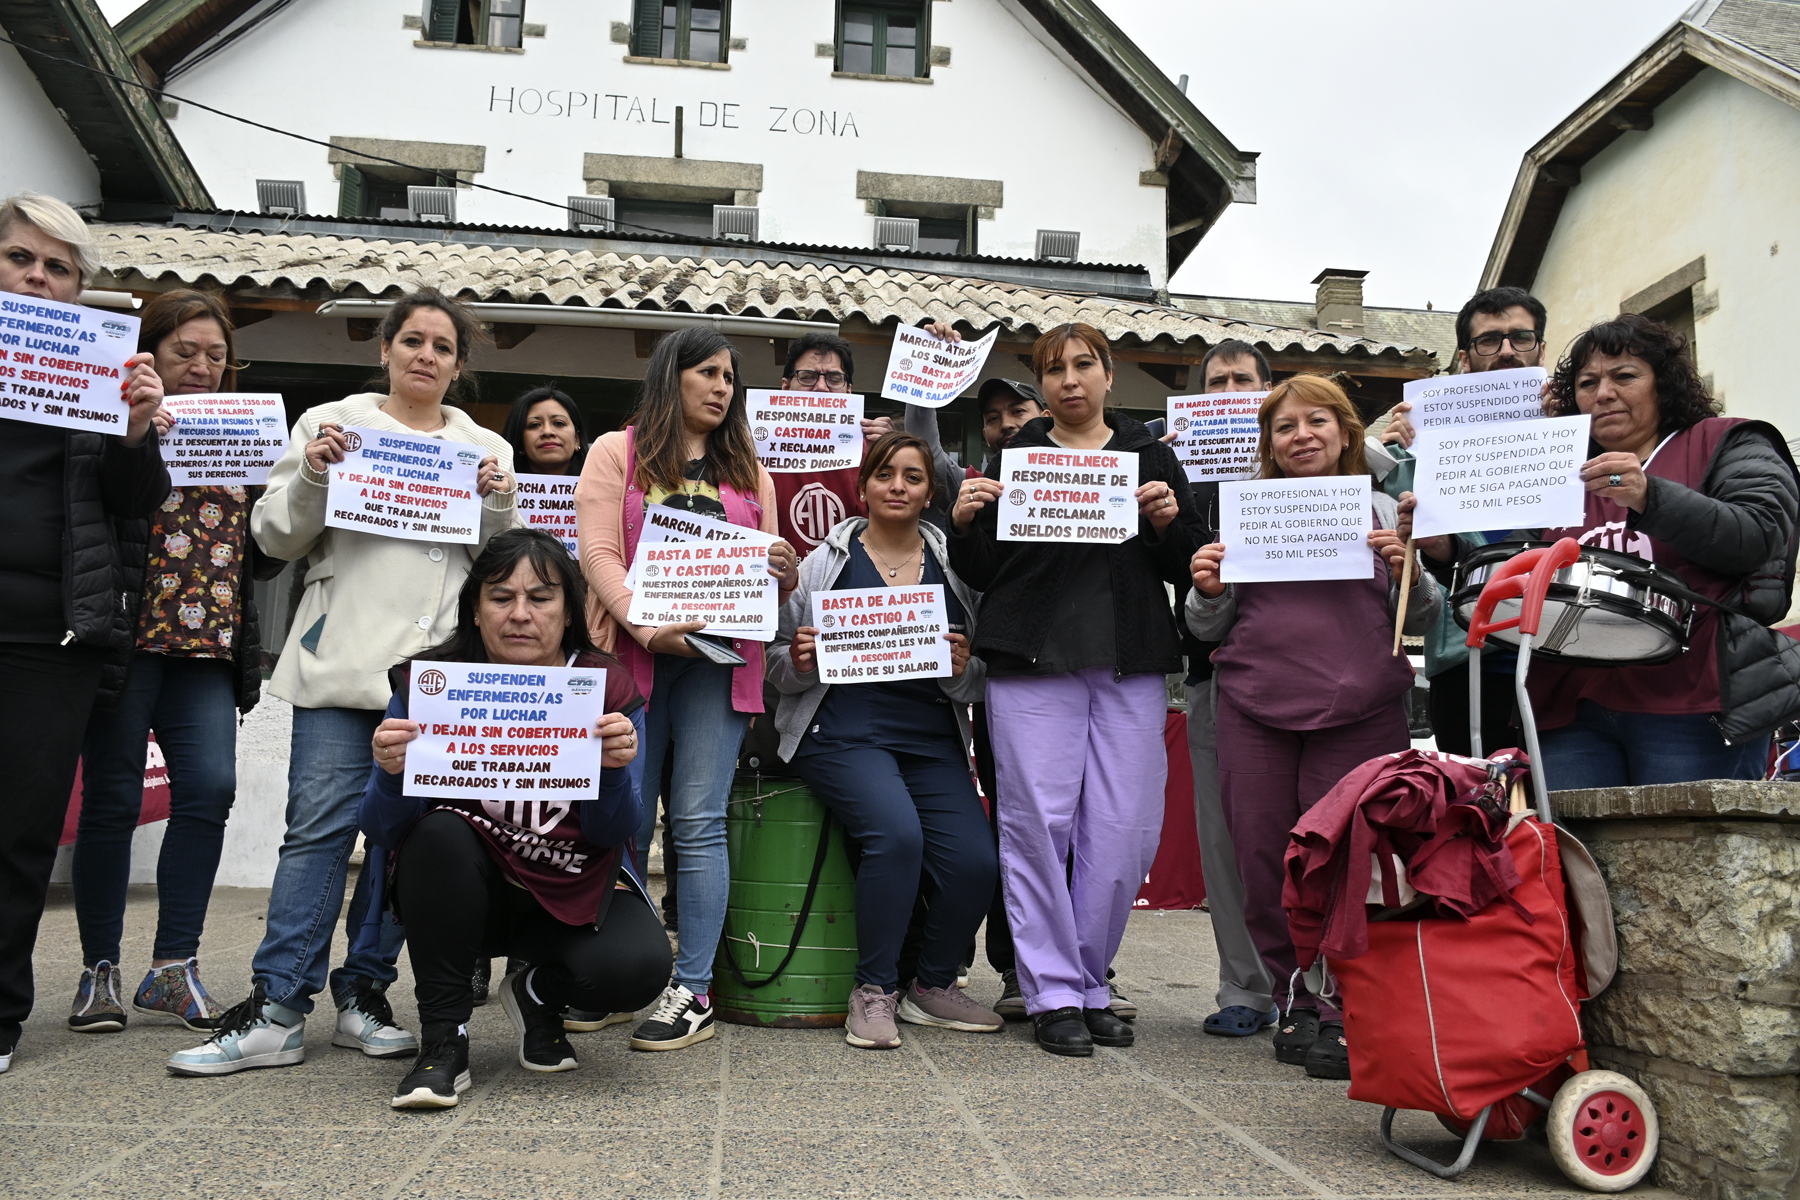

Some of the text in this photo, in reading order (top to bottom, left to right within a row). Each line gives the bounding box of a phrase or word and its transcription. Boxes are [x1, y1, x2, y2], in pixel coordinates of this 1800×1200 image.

[488, 85, 860, 137] HOSPITAL DE ZONA
[1, 301, 80, 324] SUSPENDEN
[25, 337, 80, 356] LUCHAR
[21, 370, 89, 389] SERVICIOS
[922, 366, 964, 379] BASTA DE
[12, 384, 80, 403] TRABAJAN
[891, 383, 923, 398] POR UN
[1423, 390, 1440, 398] SOY
[1444, 382, 1510, 395] PROFESIONAL
[1522, 379, 1543, 389] HOY
[770, 396, 847, 408] WERETILNECK
[1424, 394, 1544, 412] ESTOY SUSPENDIDO POR
[756, 411, 855, 424] RESPONSABLE DE
[775, 427, 830, 439] CASTIGAR
[1439, 440, 1459, 450] SOY
[1463, 433, 1538, 447] PROFESIONAL
[1552, 429, 1577, 438] HOY
[379, 438, 440, 454] SUSPENDEN
[769, 442, 835, 454] X RECLAMAR
[1199, 437, 1245, 445] DESCUENTAN
[362, 449, 453, 470] ENFERMEROS/AS
[1028, 453, 1118, 468] WERETILNECK
[1439, 444, 1573, 465] ESTOY SUSPENDIDA POR
[811, 459, 852, 468] DIGNOS
[1436, 460, 1573, 480] PEDIR AL GOBIERNO QUE
[373, 464, 440, 481] POR LUCHAR
[1012, 471, 1128, 486] RESPONSABLE DE
[349, 474, 384, 486] DEJAN
[389, 480, 404, 490] SIN
[408, 483, 470, 499] COBERTURA
[1440, 476, 1566, 495] NO ME SIGA PAGANDO
[360, 488, 447, 509] A LOS SERVICIOS
[1034, 489, 1099, 503] CASTIGAR
[1240, 493, 1258, 501] SOY
[1262, 489, 1328, 499] PROFESIONAL
[1460, 494, 1541, 509] 350 MIL PESOS
[365, 502, 440, 520] QUE TRABAJAN
[1028, 507, 1105, 520] X RECLAMAR
[1242, 506, 1271, 515] ESTOY
[1274, 504, 1337, 514] SUSPENDIDA
[334, 510, 398, 528] RECARGADOS
[412, 523, 427, 531] SIN
[431, 525, 471, 535] INSUMOS
[1240, 521, 1267, 530] PEDIR
[1285, 518, 1338, 528] GOBIERNO
[1341, 518, 1362, 526] QUE
[1010, 524, 1129, 539] SUELDOS DIGNOS
[1282, 535, 1304, 543] SIGA
[1308, 532, 1358, 542] PAGANDO
[648, 547, 768, 560] BASTA DE AJUSTE
[1266, 550, 1283, 559] 350
[1307, 549, 1337, 557] PESOS
[664, 567, 671, 576] Y
[676, 564, 730, 576] CASTIGO
[735, 564, 744, 575] A
[692, 578, 768, 588] COMPAÑEROS/AS
[822, 592, 934, 610] BASTA DE AJUSTE
[839, 616, 846, 627] Y
[852, 612, 902, 626] CASTIGO
[907, 610, 916, 621] A
[821, 624, 940, 641] NUESTROS COMPAÑEROS/AS
[825, 636, 935, 652] ENFERMERAS/OS LES VAN
[861, 651, 911, 662] DESCONTAR
[842, 666, 863, 677] DÍAS
[867, 667, 879, 675] DE
[883, 665, 894, 674] SU
[898, 661, 938, 673] SALARIO
[468, 672, 545, 686] SUSPENDEN
[448, 689, 563, 704] ENFERMEROS/AS
[461, 708, 547, 721] POR LUCHAR
[419, 724, 587, 738] Y DEJAN SIN COBERTURA
[446, 742, 558, 756] A LOS SERVICIOS
[452, 760, 550, 772] QUE TRABAJAN
[414, 774, 590, 788] RECARGADOS Y SIN INSUMOS
